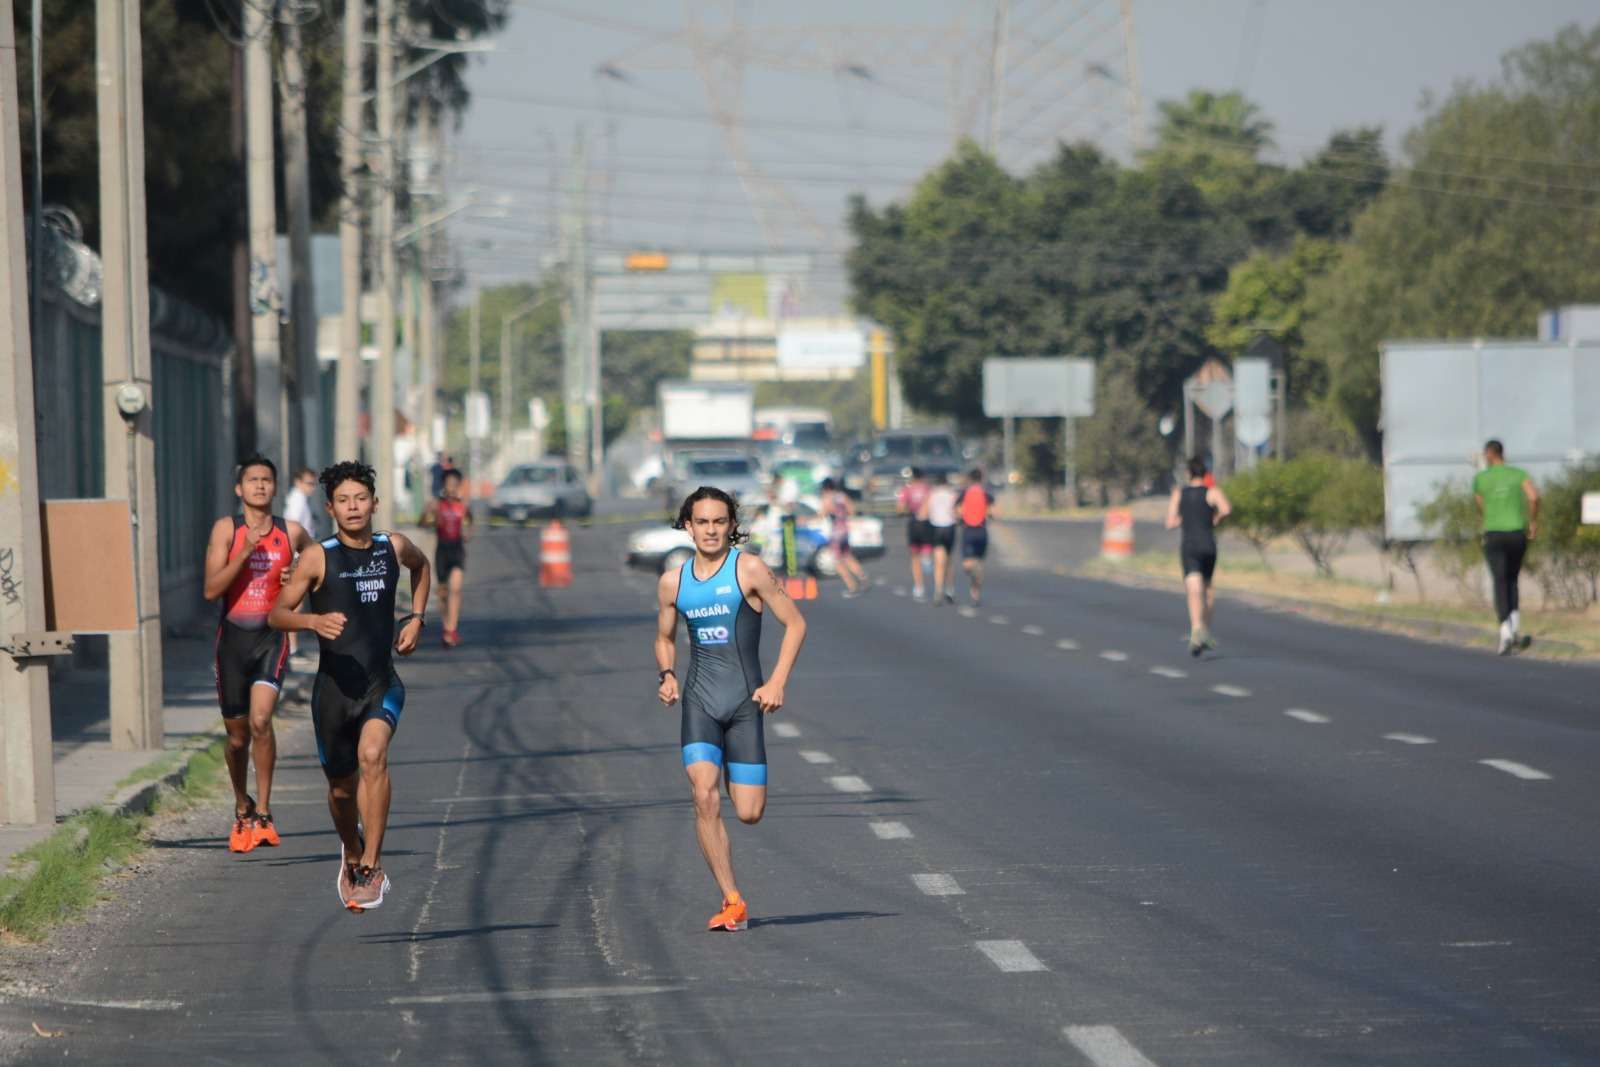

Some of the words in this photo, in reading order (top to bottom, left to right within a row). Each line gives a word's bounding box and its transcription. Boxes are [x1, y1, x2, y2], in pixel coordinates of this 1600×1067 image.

[356, 579, 385, 592] ISHIDA
[361, 591, 378, 603] GTO
[686, 604, 730, 619] MAGAÑA
[698, 627, 728, 640] GTO
